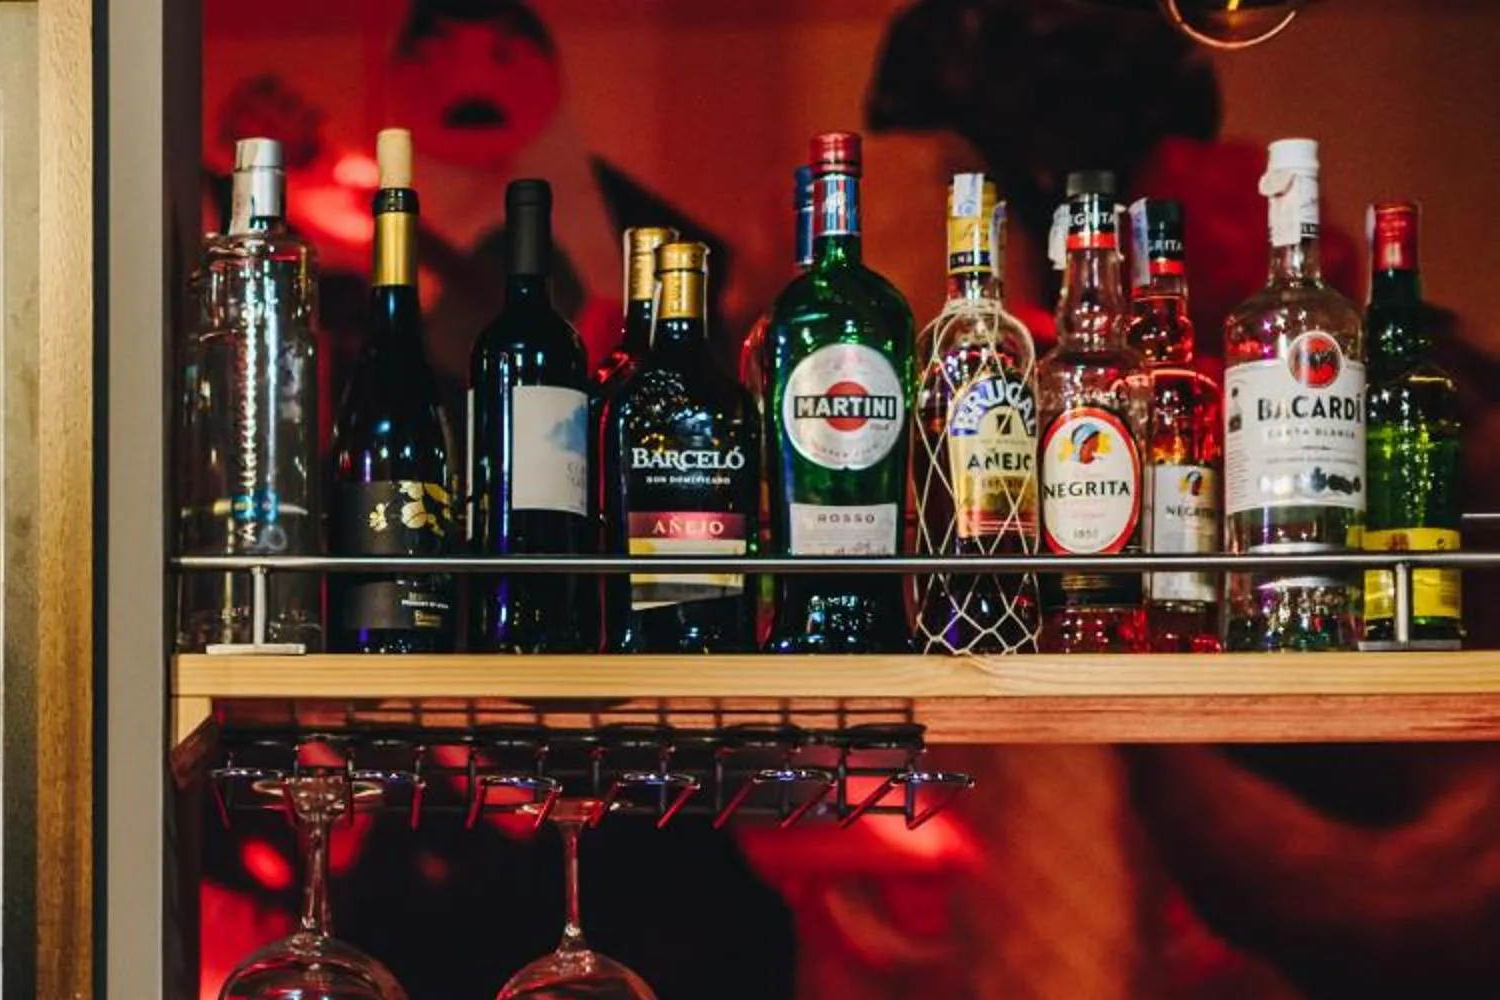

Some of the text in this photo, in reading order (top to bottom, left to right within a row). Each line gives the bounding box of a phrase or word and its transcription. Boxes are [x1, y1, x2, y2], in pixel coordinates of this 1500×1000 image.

[797, 396, 895, 418] MARTINI
[631, 446, 745, 471] BARCELÓ
[1043, 480, 1131, 499] NEGRITA
[652, 517, 725, 535] AÑEJO
[817, 513, 875, 524] ROSSO
